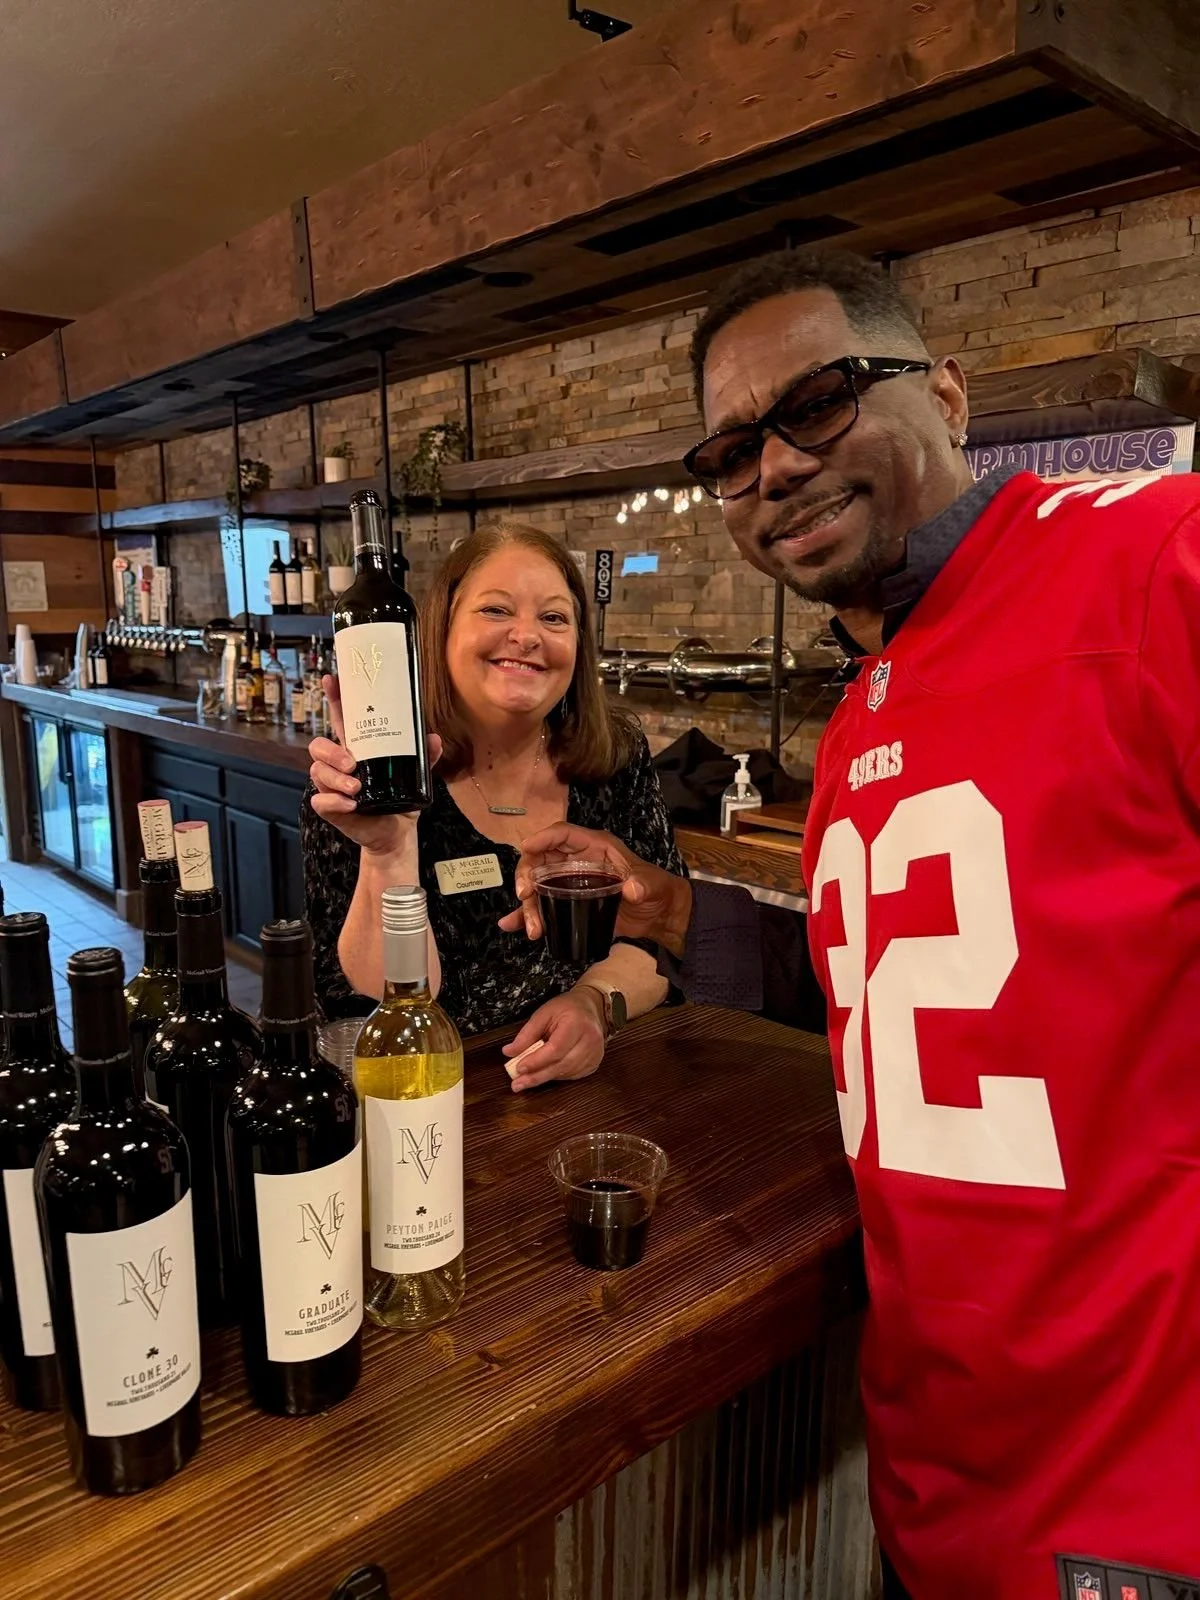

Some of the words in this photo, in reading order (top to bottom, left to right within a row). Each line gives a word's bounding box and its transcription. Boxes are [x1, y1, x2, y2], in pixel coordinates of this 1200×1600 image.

[597, 553, 611, 598] 805
[355, 718, 376, 730] CLONE
[379, 717, 389, 726] 30
[847, 740, 903, 791] 49ERS
[456, 880, 483, 888] Courtney
[386, 1223, 424, 1235] PEYTON
[428, 1212, 453, 1232] PAIGE
[298, 1289, 350, 1320] GRADUATE
[123, 1364, 162, 1388] CLONE
[166, 1354, 178, 1371] 30
